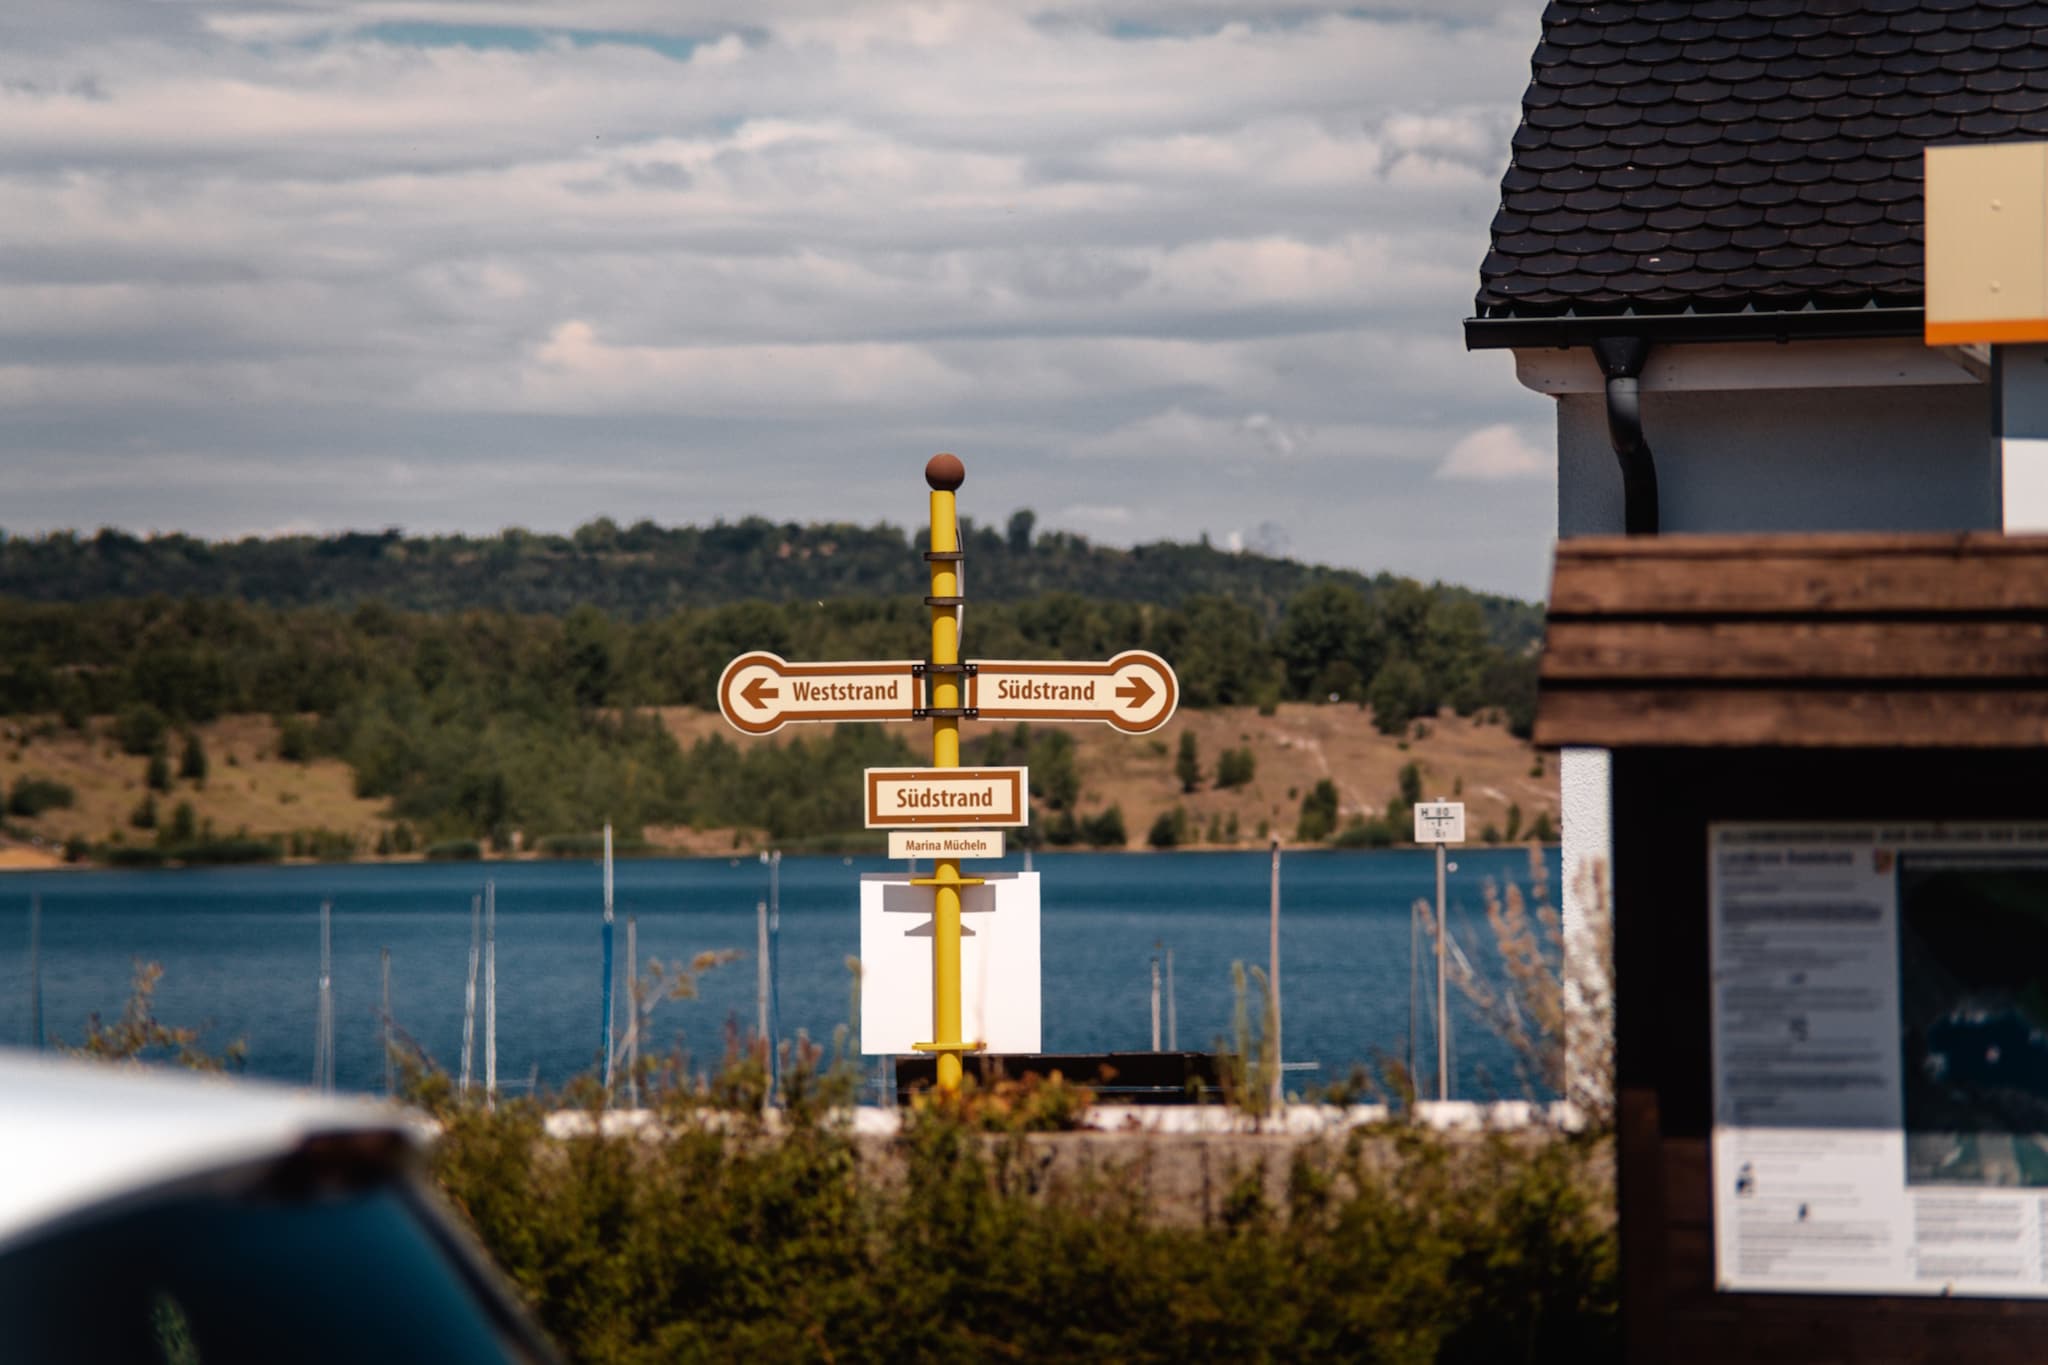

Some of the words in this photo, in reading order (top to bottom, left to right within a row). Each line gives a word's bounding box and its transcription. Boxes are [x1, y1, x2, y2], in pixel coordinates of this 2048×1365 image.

[792, 679, 898, 701] Weststrand
[998, 679, 1095, 701] Südstrand
[896, 786, 993, 808] Südstrand
[905, 840, 941, 851] Marina
[943, 839, 987, 851] Mücheln
